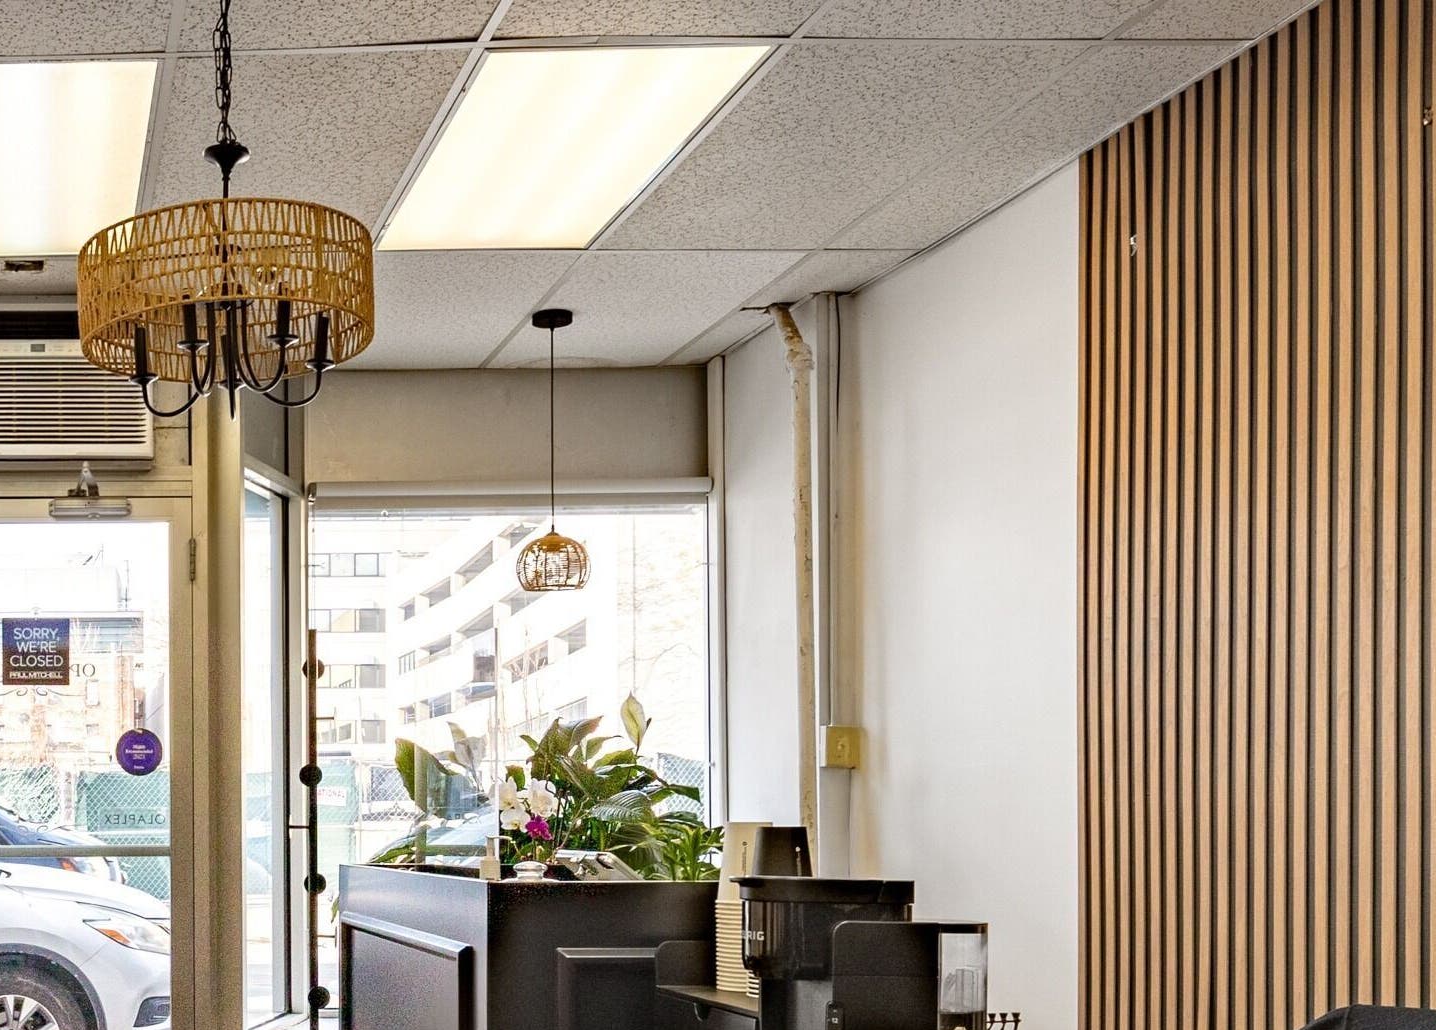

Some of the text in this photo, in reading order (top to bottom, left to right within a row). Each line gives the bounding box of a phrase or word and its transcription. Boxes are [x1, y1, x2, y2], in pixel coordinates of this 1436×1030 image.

[13, 627, 61, 642] SORRY,
[16, 641, 57, 653] WE'RE
[9, 655, 64, 667] CLOSED
[9, 671, 63, 679] PAUL MITCHELL
